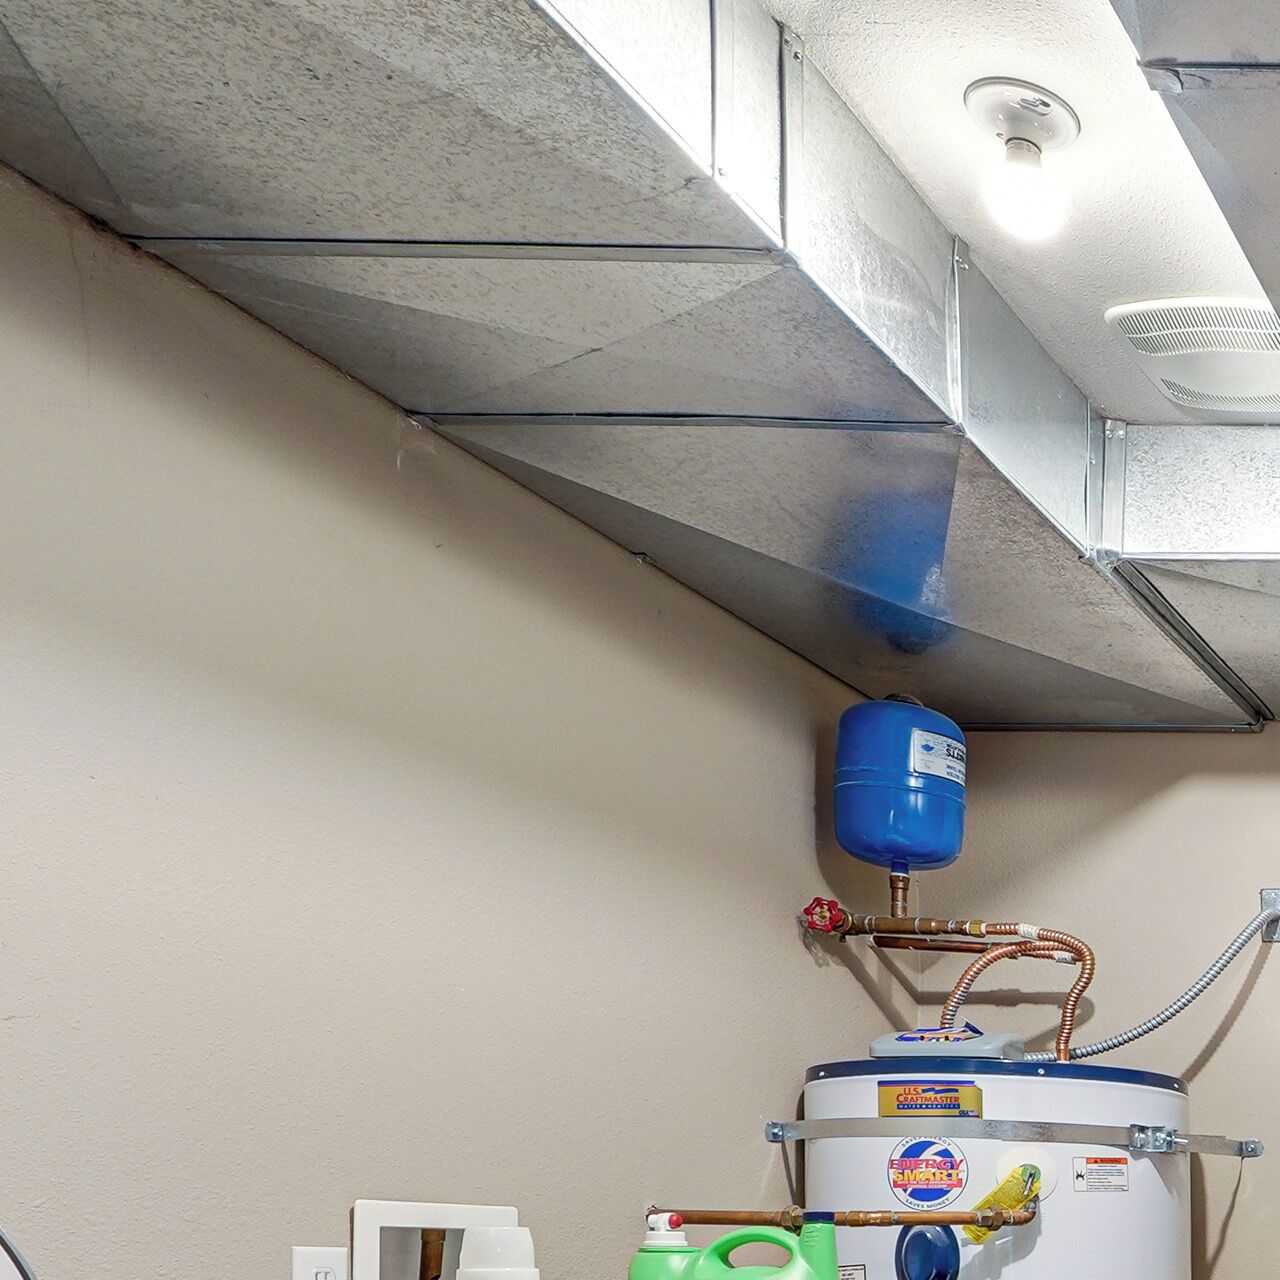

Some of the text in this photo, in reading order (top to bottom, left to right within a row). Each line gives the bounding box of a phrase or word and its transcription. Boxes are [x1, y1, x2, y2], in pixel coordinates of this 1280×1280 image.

[903, 1087, 921, 1096] U.S.
[896, 1093, 960, 1103] CRAFTMASTER
[889, 1158, 965, 1170] ENERGY
[894, 1169, 961, 1182] SMART
